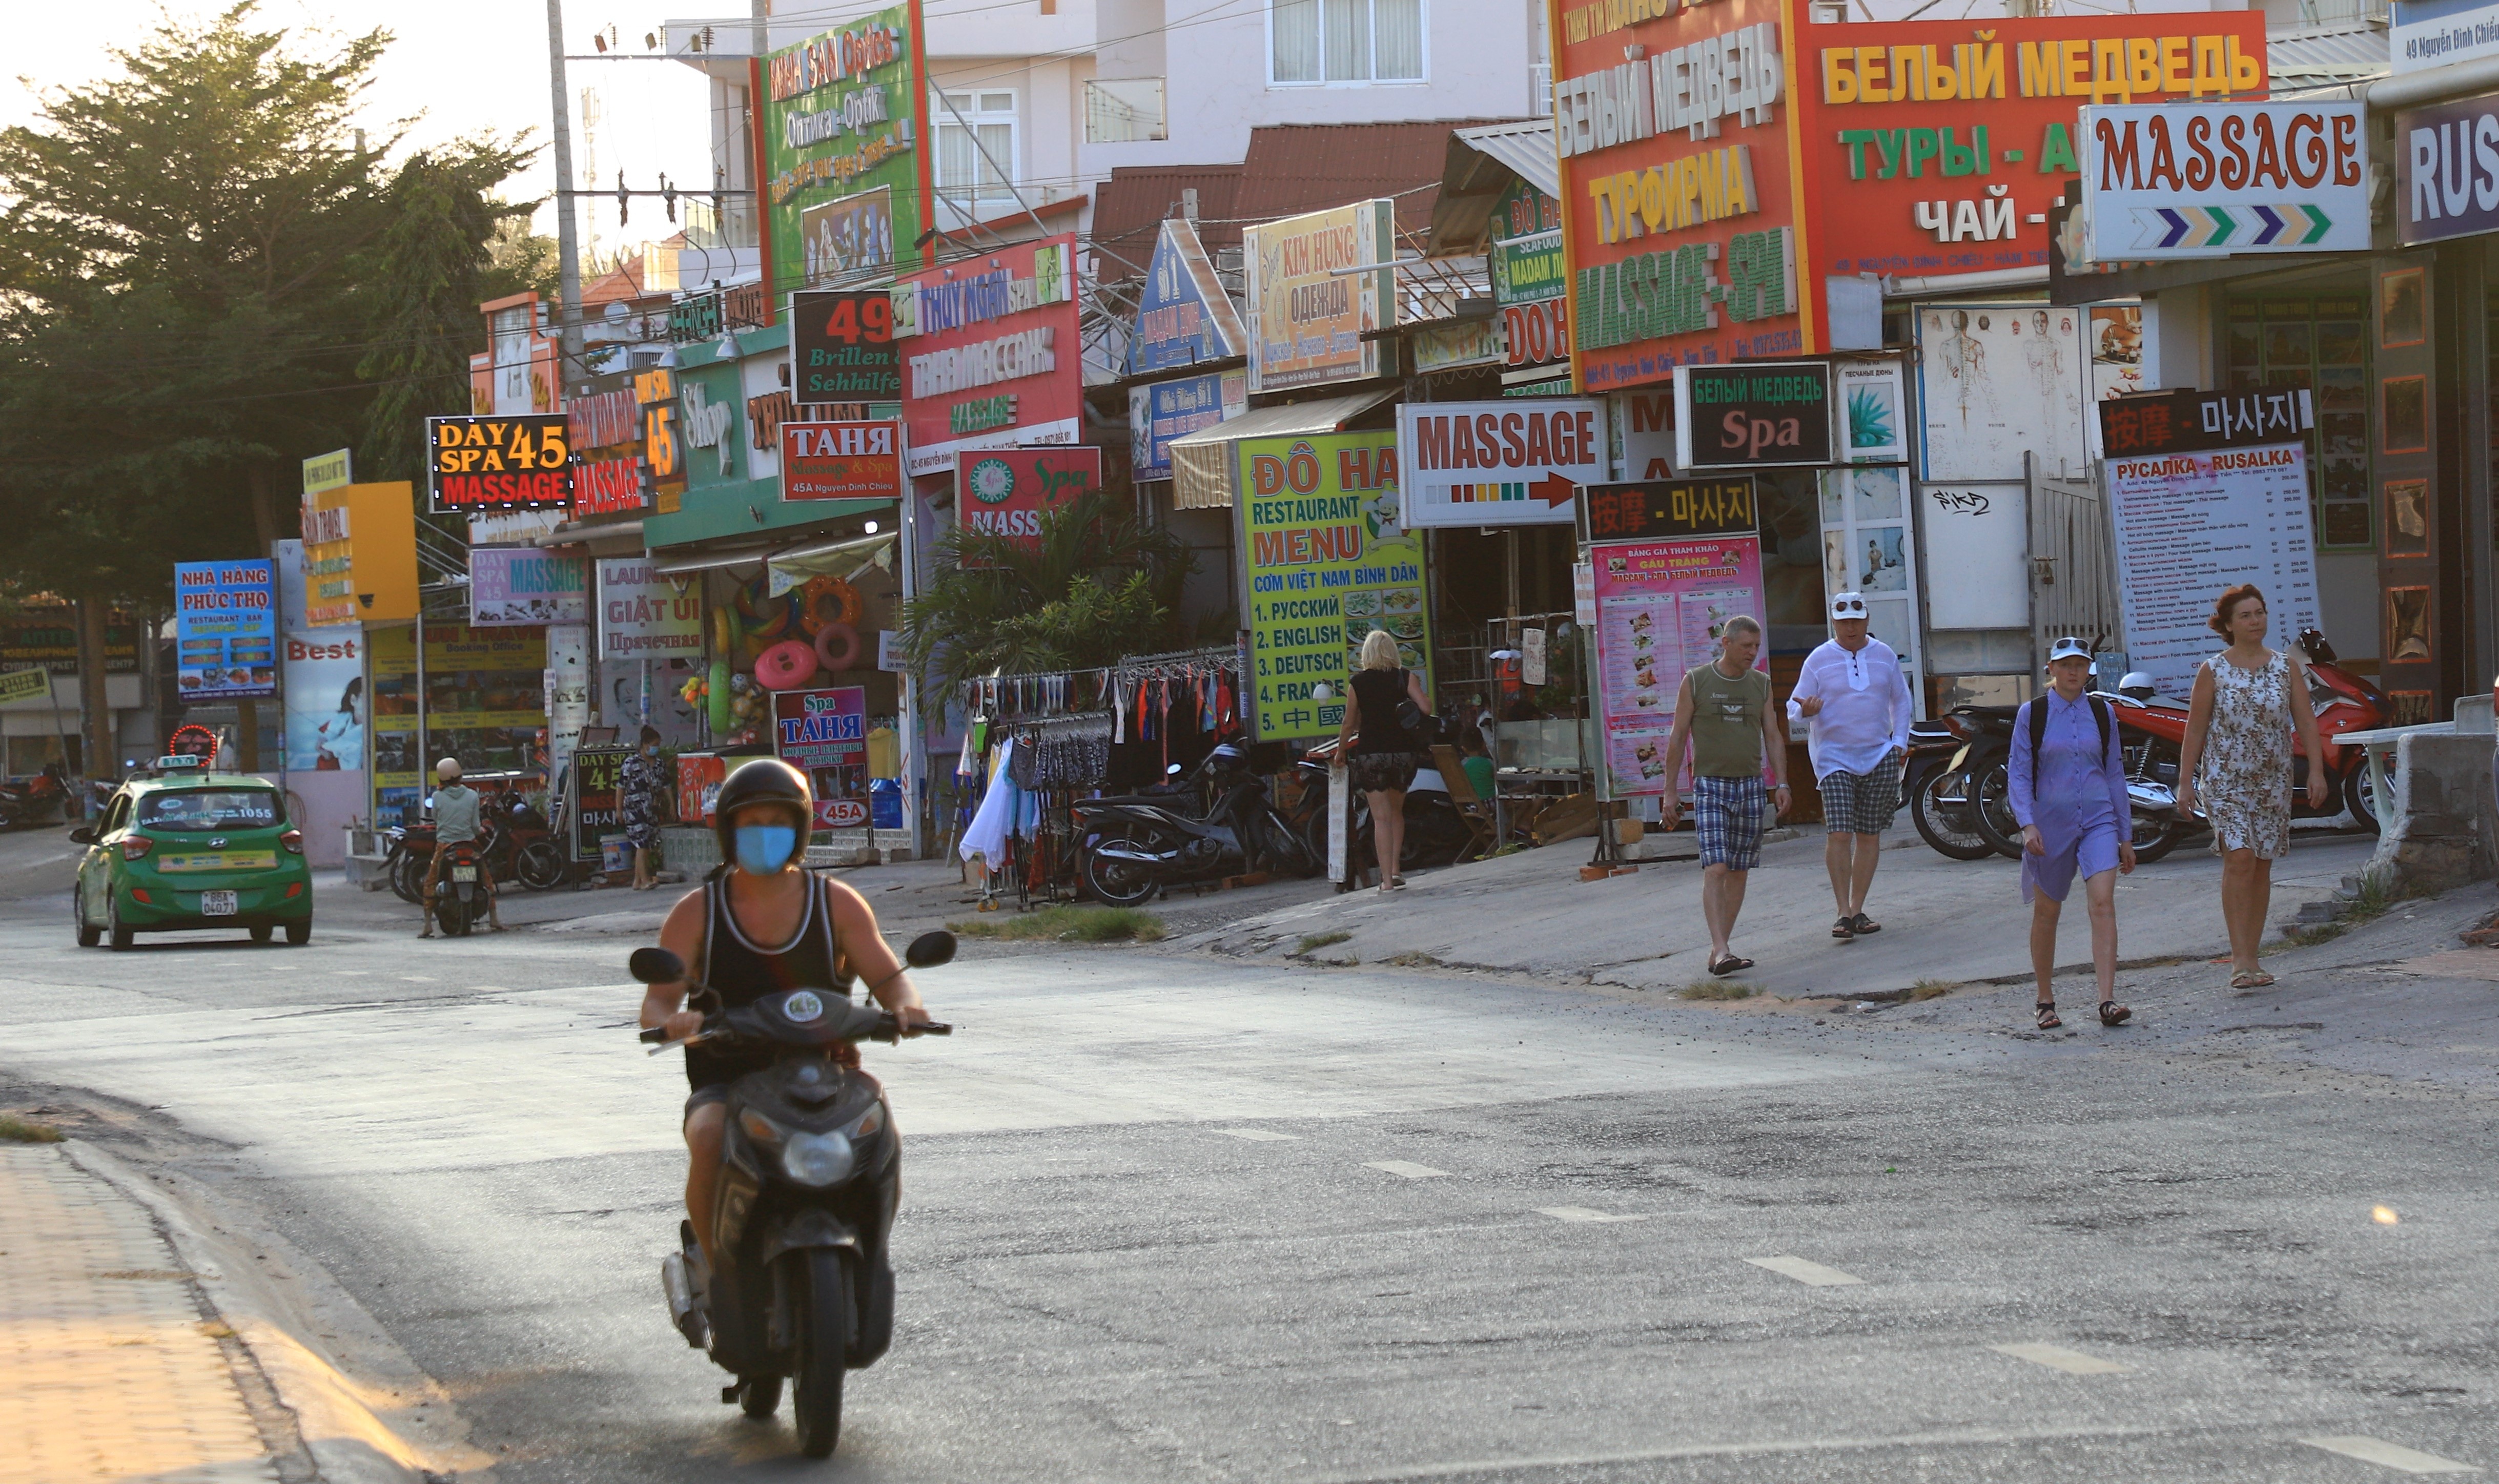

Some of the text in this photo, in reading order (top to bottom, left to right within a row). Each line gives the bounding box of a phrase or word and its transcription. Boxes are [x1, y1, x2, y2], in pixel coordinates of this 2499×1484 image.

[808, 37, 839, 89] SAN
[843, 24, 894, 84] Optics
[2406, 40, 2418, 60] 49
[2419, 29, 2451, 59] Nguyễn
[2453, 28, 2473, 51] Đình
[1828, 29, 2261, 105] БЕЛЫЙ МЕДВЕДЬ
[1559, 23, 1780, 158] БЕЛЫЙ МЕДВЕДЬ
[787, 85, 879, 149] Оптика Optik
[1841, 126, 1990, 179] ТУРЫ
[2096, 112, 2361, 192] MASSAGE
[1589, 146, 1747, 244] ТУРФИРМА
[1918, 184, 2017, 243] ЧАЙ
[1283, 234, 1310, 279] KIM
[1511, 255, 1550, 286] MADAM
[1291, 278, 1350, 327] ОДЕЖДА
[826, 297, 892, 344] 49
[809, 348, 889, 367] Brillen
[909, 328, 1048, 399] ТАНЯ МАССАЖ
[809, 371, 900, 394] Sehhilfe
[1694, 373, 1822, 406] БЕЛЫЙ МЕДВЕДЬ
[683, 382, 732, 476] Shop
[951, 395, 1010, 434] MASSAGE
[2107, 391, 2297, 451] 按摩 마사지
[439, 423, 567, 469] DAY 45
[647, 407, 673, 477] 45
[790, 427, 893, 457] ТАНЯ
[1417, 411, 1596, 470] MASSAGE
[1721, 410, 1800, 459] Spa
[440, 449, 506, 473] SPA
[791, 458, 893, 480] Massage & Spa
[1251, 441, 1321, 497] ĐÔ
[2117, 449, 2294, 480] РУСАЛКА RUSALKA
[443, 471, 567, 504] MASSAGE
[572, 457, 642, 517] MASSAGE
[792, 482, 893, 493] 45A Nguyen Dinh Chieu
[1019, 457, 1089, 501] Spa
[1253, 495, 1360, 525] RESTAURANT
[1592, 483, 1753, 535] 按摩 마사지
[477, 553, 507, 567] DAY
[1254, 525, 1363, 567] MENU
[1670, 546, 1693, 554] THAM
[182, 565, 269, 586] NHÀ HÀNG
[478, 557, 585, 593] SPA MASSAGE
[1255, 561, 1418, 593] CƠM VIỆT NAM BÌNH DÂN
[1611, 572, 1646, 584] МАССАЖ
[1700, 566, 1738, 579] МЕДВЕДЬ
[233, 591, 269, 610] THỌ
[483, 586, 502, 600] 45
[1255, 594, 1340, 623] 1. РУССКИЙ
[188, 615, 239, 624] RESTAURANT
[608, 594, 667, 627] GIẶT
[446, 641, 524, 653] Booking Office
[465, 625, 545, 642] TRAVE
[608, 633, 701, 655] Прачечная
[1257, 625, 1341, 650] 2. ENGLISH
[288, 640, 356, 661] Best
[1258, 652, 1344, 677] 3. DEUTSCH
[805, 694, 835, 713] Spa
[1260, 686, 1274, 704] 4.
[780, 713, 864, 744] ТАНЯ
[1262, 713, 1275, 731] 5.
[579, 754, 606, 767] DAY
[782, 746, 819, 758] МОДНЫЕ
[805, 754, 843, 766] КОСИЧКИ
[239, 808, 273, 819] 1055
[826, 803, 863, 819] 45A
